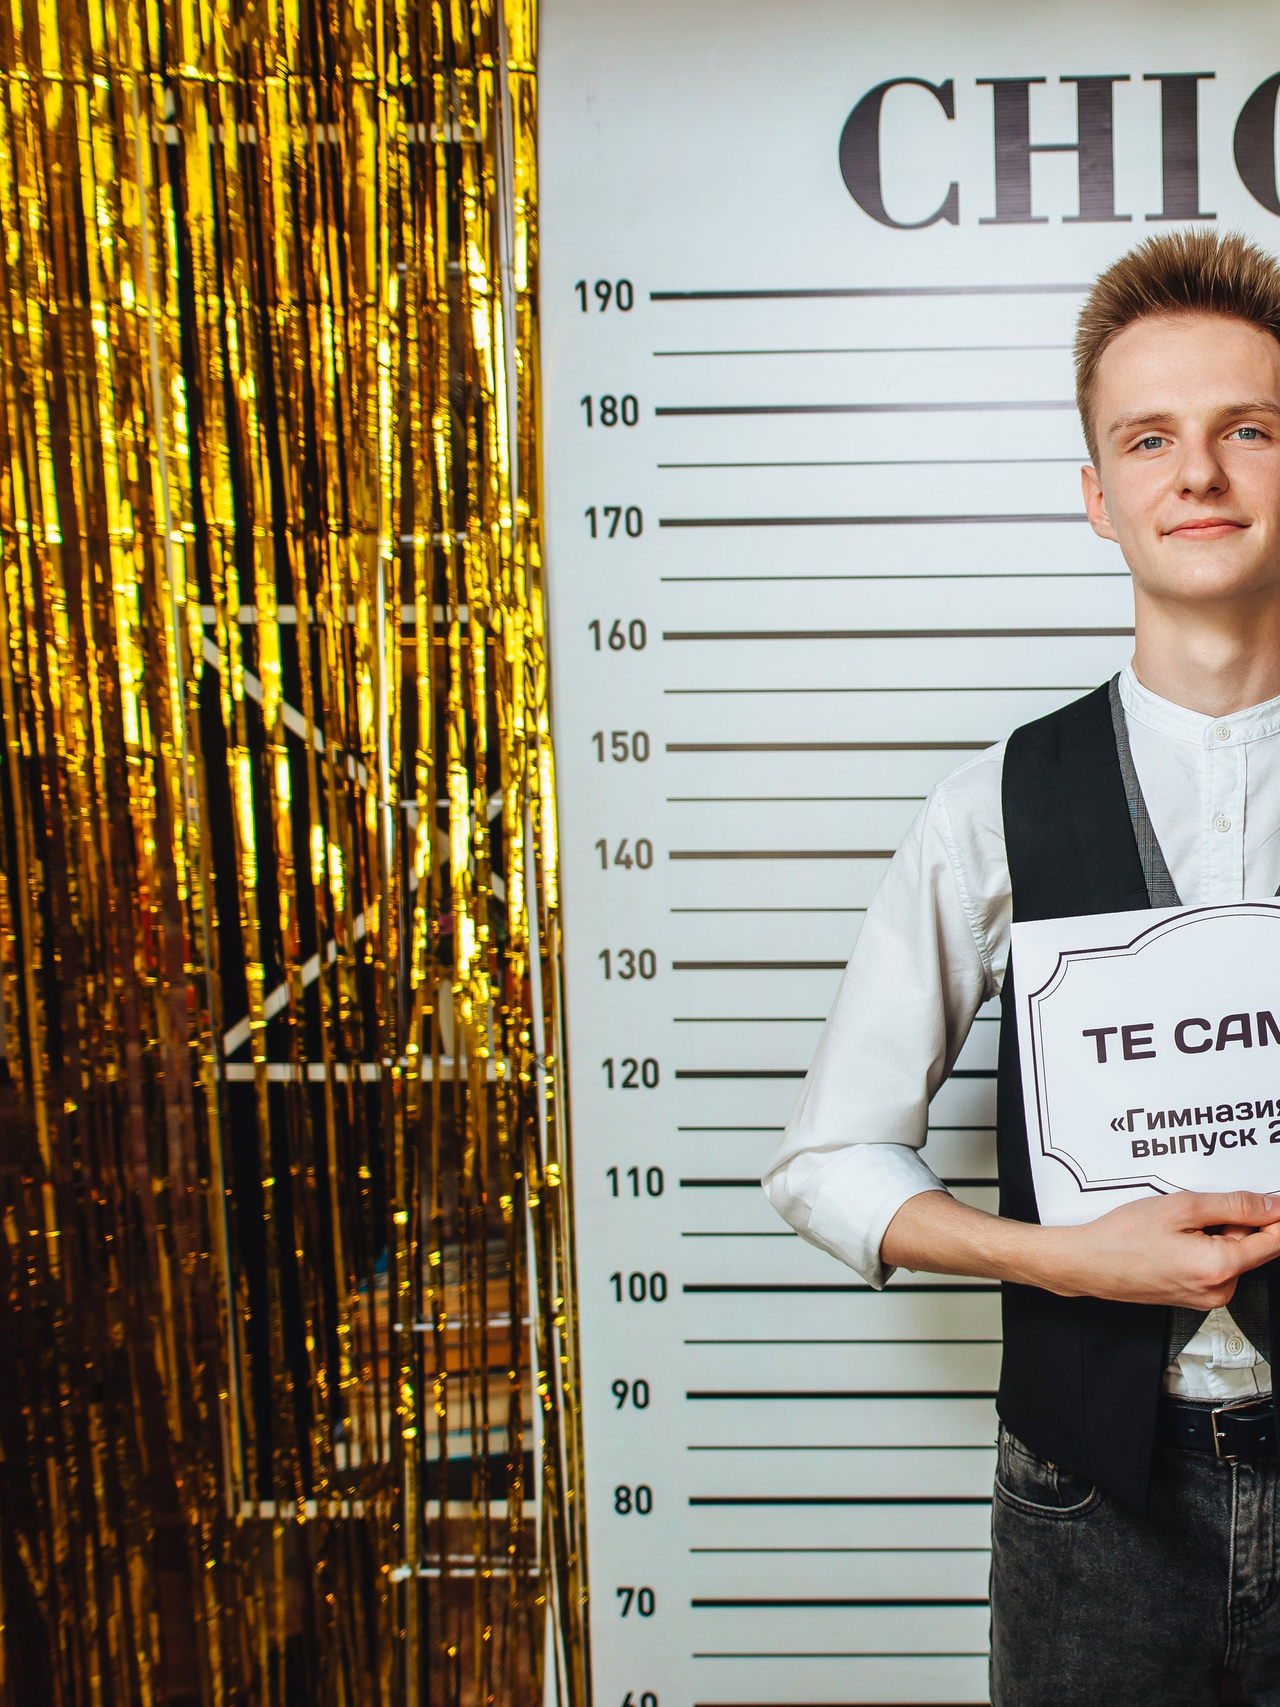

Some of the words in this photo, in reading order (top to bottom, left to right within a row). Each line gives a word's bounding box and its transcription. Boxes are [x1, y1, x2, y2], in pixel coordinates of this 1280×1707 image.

[574, 278, 634, 313] 190
[580, 394, 639, 428] 180
[584, 505, 643, 539] 170
[588, 619, 647, 651] 160
[591, 730, 650, 763] 150
[594, 838, 654, 870] 140
[598, 948, 657, 980] 130
[1082, 1022, 1157, 1064] ТЕ
[601, 1057, 660, 1089] 120
[1131, 1129, 1258, 1159] выпуск
[606, 1166, 664, 1197] 110
[609, 1271, 668, 1303] 100
[611, 1378, 650, 1410] 90
[614, 1484, 653, 1516] 80
[616, 1586, 656, 1618] 70
